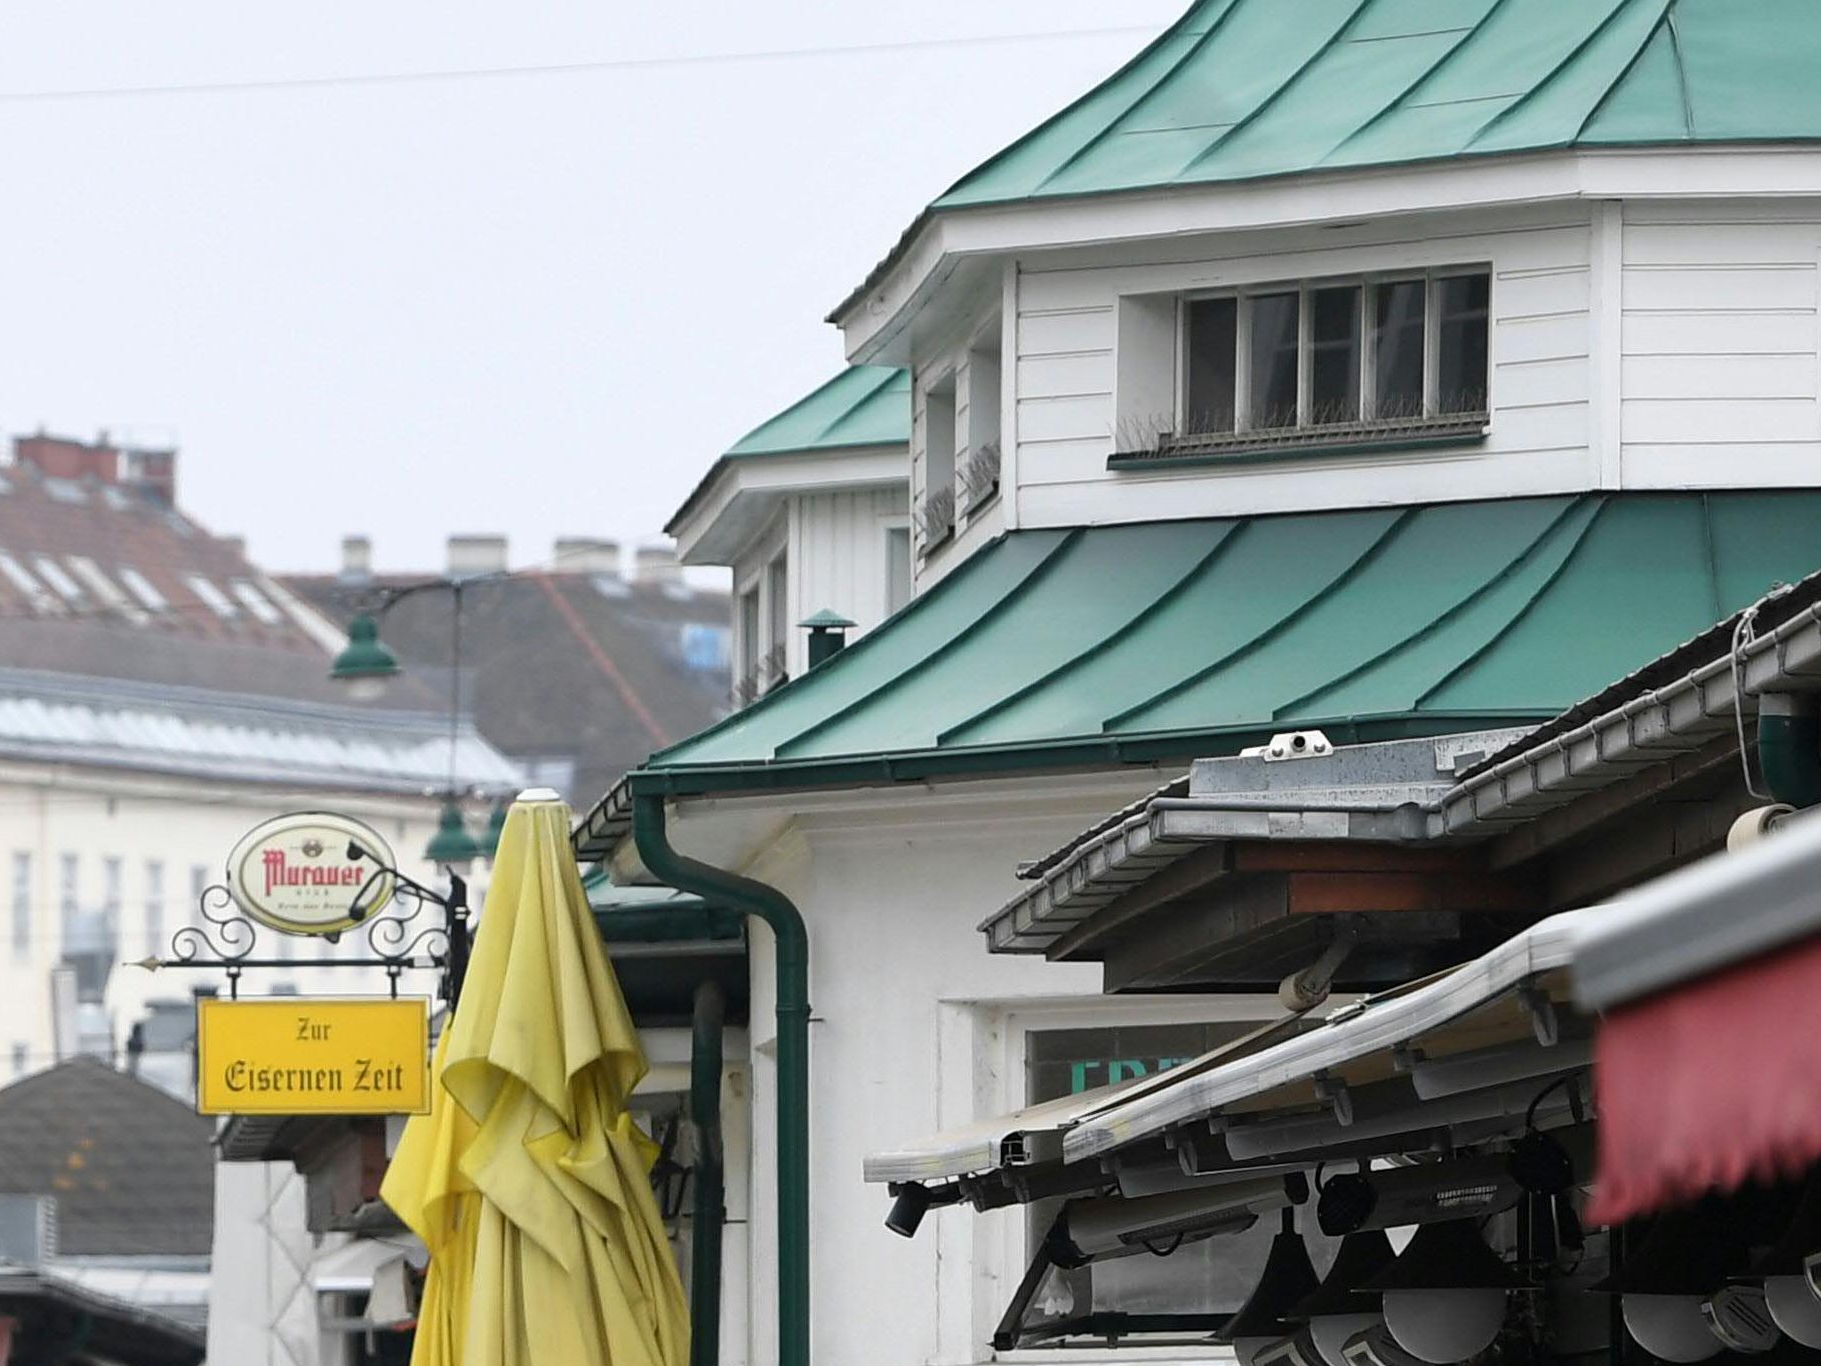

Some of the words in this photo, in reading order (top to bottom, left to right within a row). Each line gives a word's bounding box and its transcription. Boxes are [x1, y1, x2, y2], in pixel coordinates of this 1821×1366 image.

[262, 849, 364, 897] Murauer
[296, 1018, 331, 1041] Zur
[225, 1060, 342, 1093] Eisernen
[353, 1058, 403, 1092] Zeit
